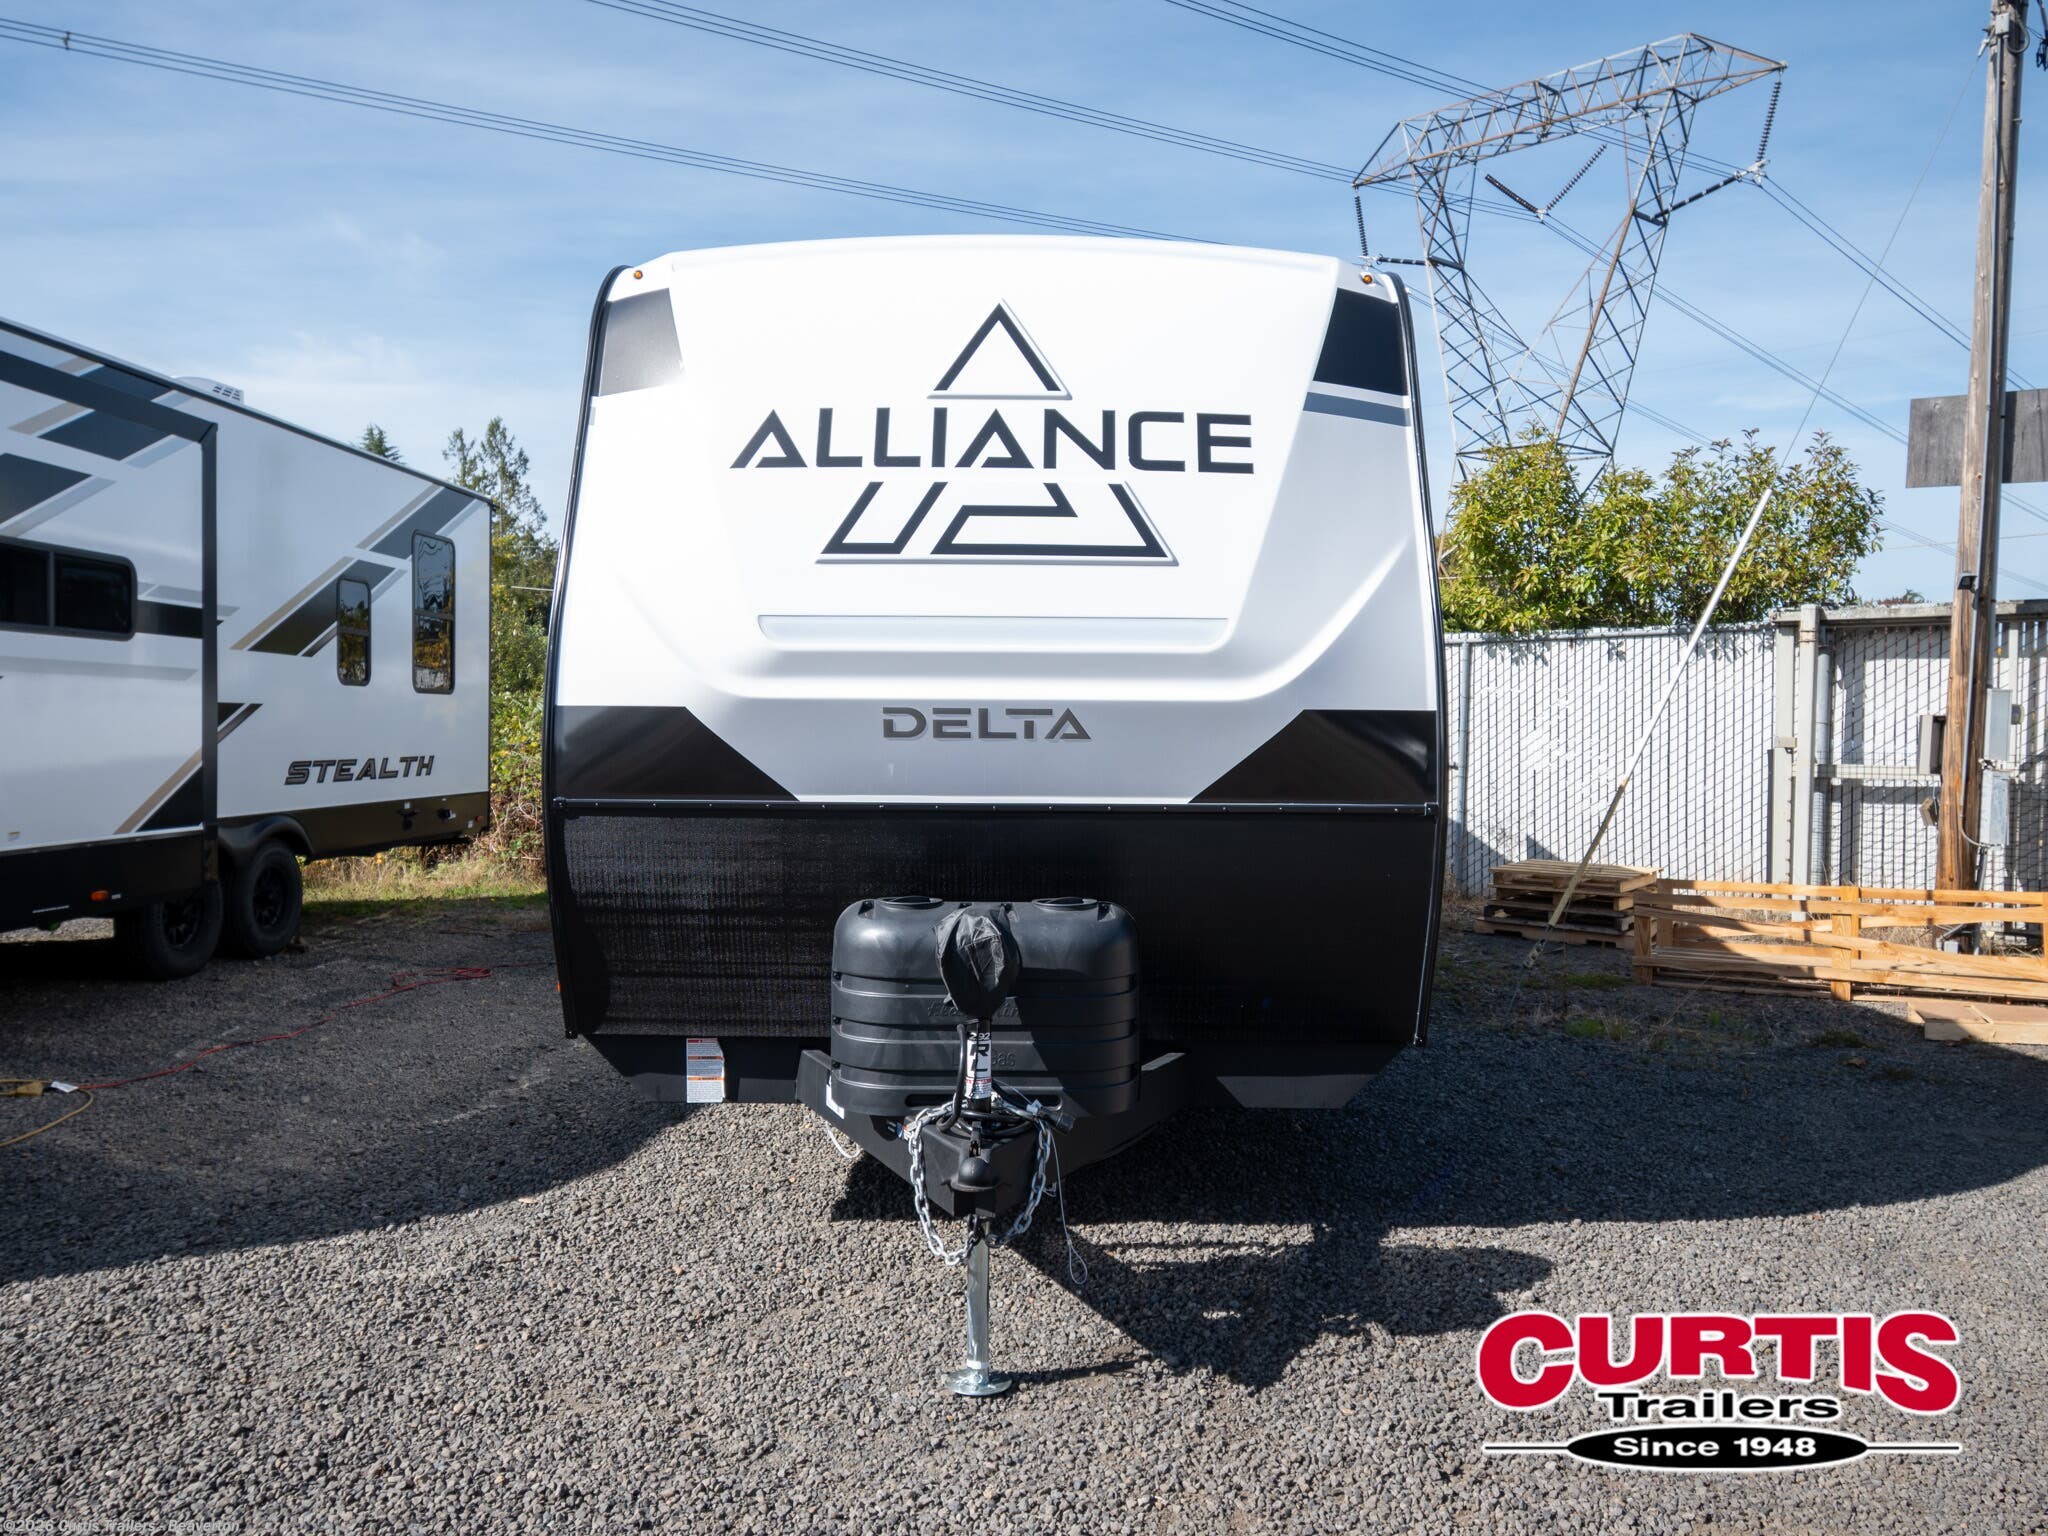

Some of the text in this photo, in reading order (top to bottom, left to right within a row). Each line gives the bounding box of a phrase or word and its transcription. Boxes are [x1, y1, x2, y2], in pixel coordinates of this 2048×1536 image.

[729, 407, 1254, 474] ALLIANCE
[882, 706, 1092, 740] DELTA
[284, 754, 435, 786] STEALTH
